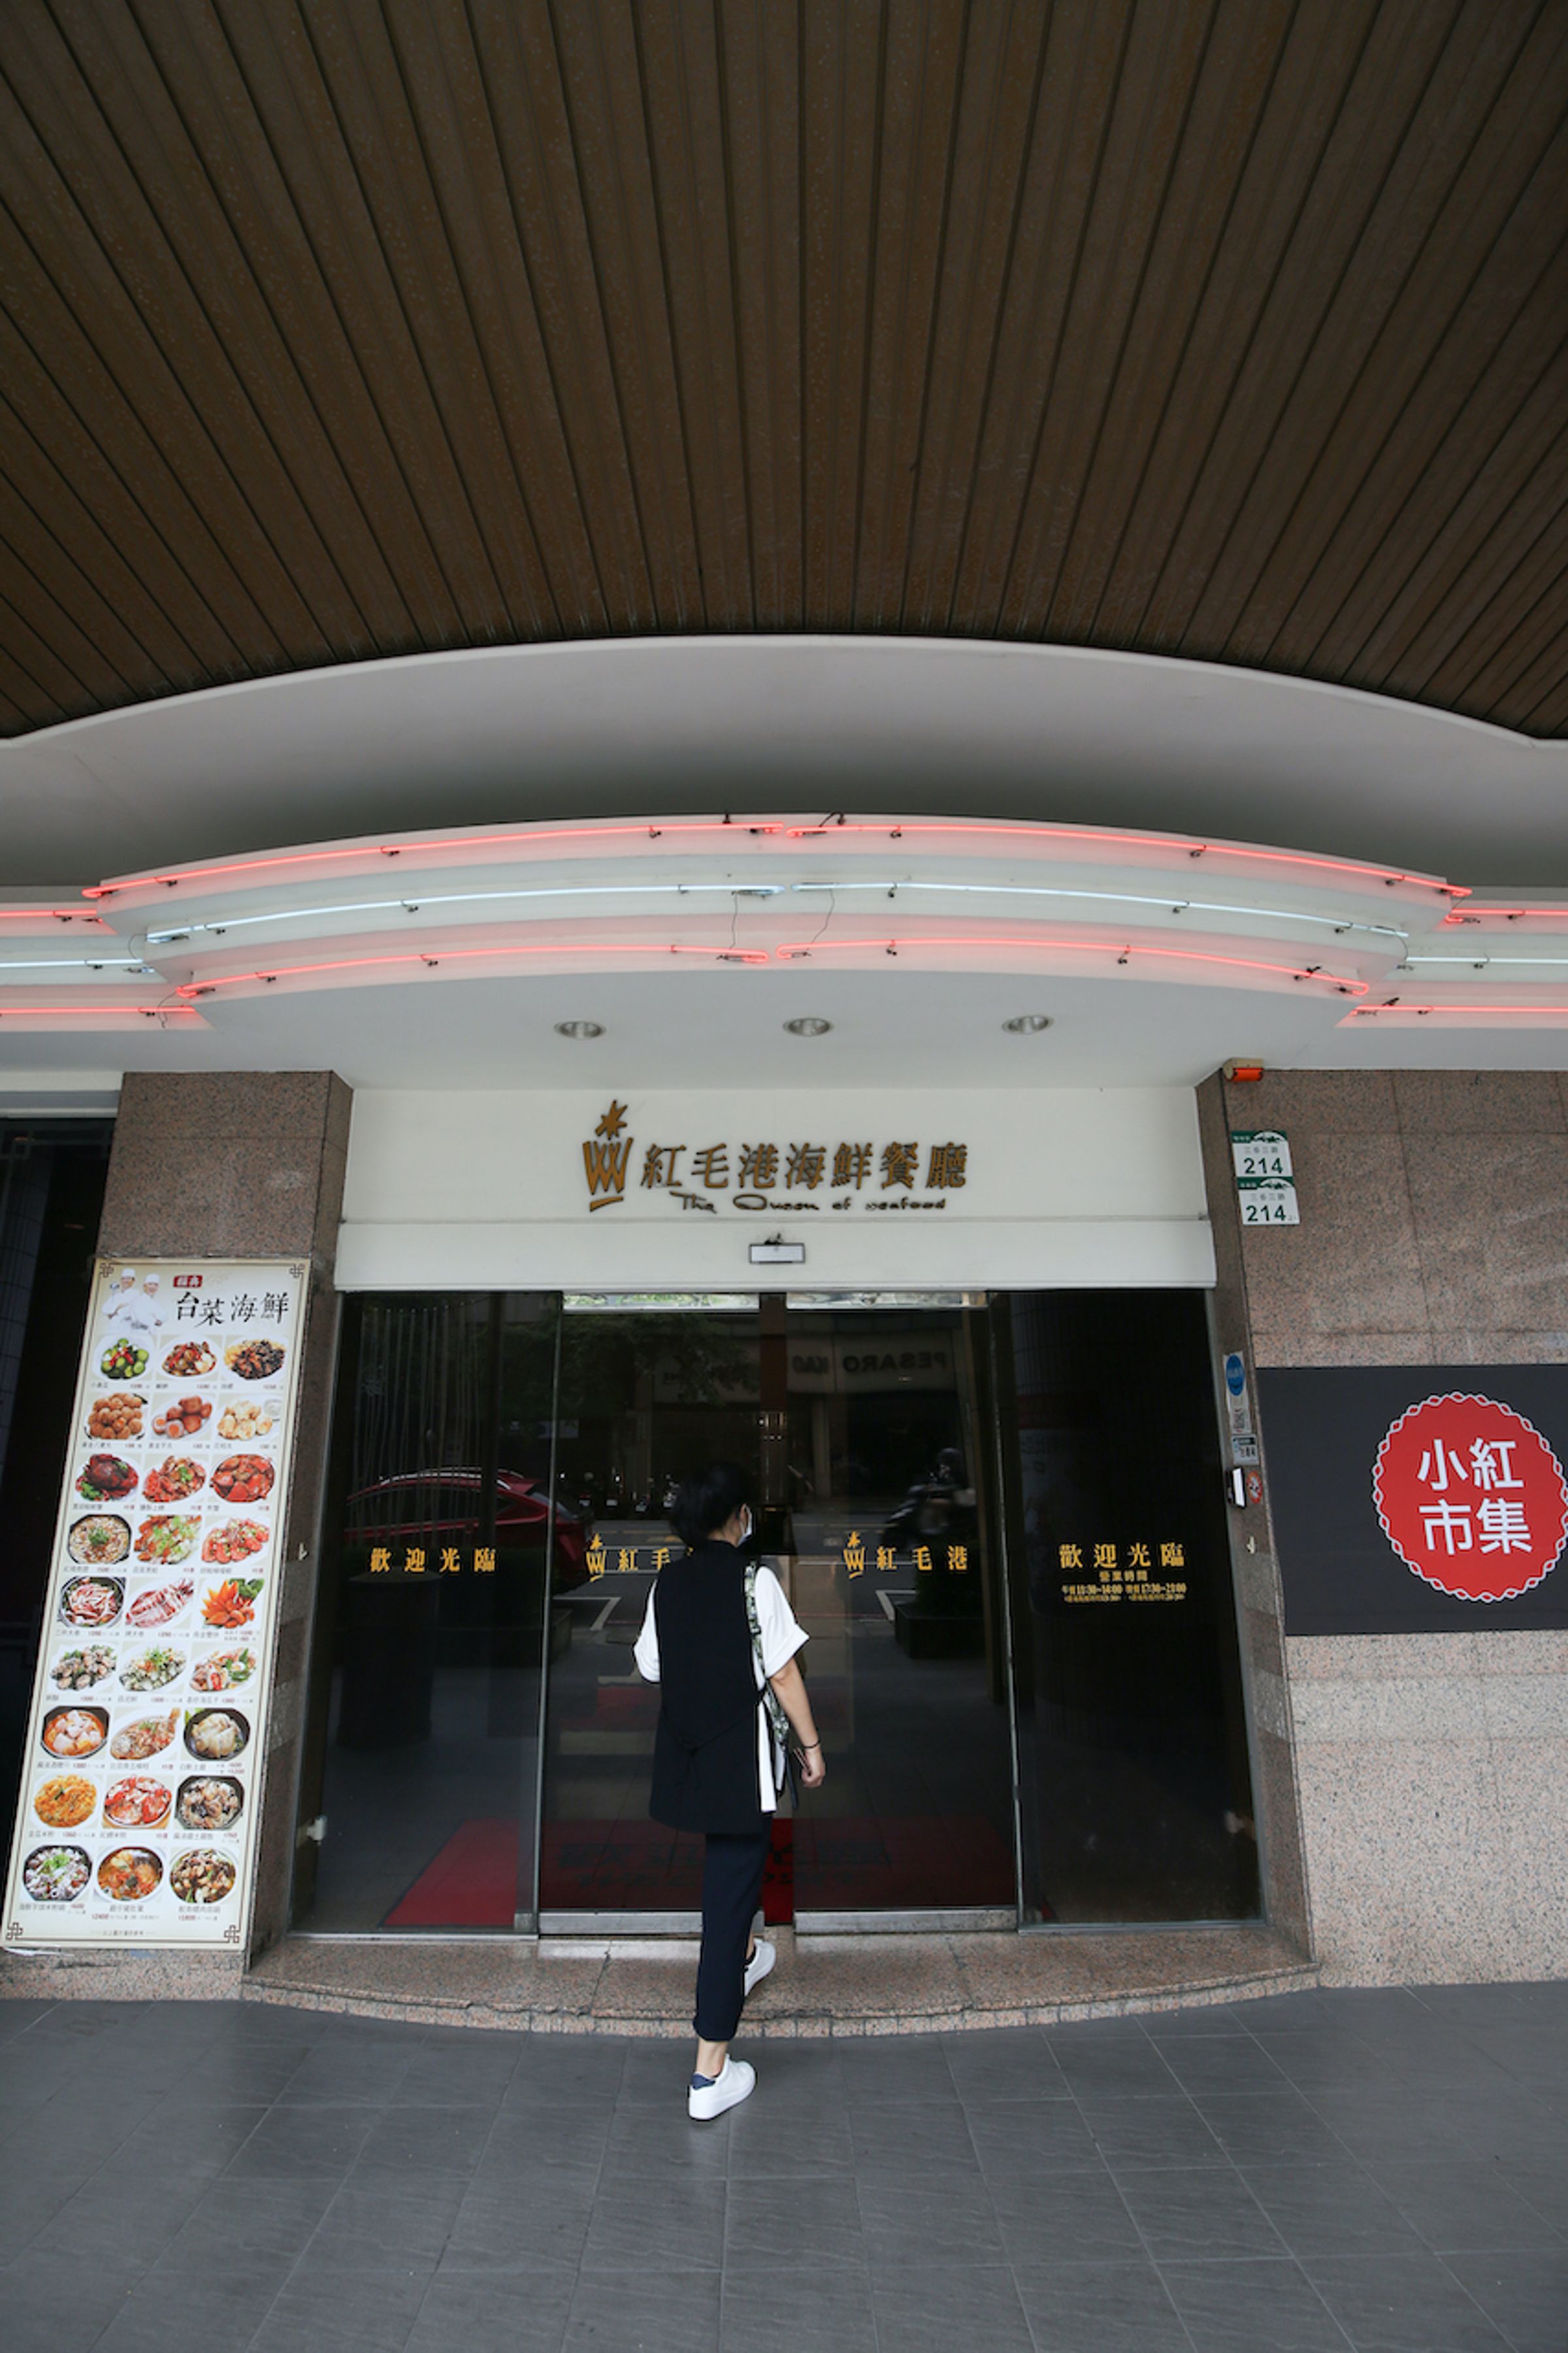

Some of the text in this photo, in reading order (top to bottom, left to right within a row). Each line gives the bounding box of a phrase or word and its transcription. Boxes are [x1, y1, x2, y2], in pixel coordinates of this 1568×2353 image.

[640, 1141, 968, 1190] 紅毛港海鮮餐廳
[1244, 1157, 1283, 1174] 214
[669, 1191, 717, 1214] The
[733, 1194, 819, 1211] Queen
[832, 1196, 851, 1211] of
[1246, 1205, 1286, 1222] 214
[176, 1291, 289, 1328] 台菜海鮮
[1417, 1438, 1524, 1491] 小紅
[1418, 1498, 1533, 1556] 市集
[370, 1547, 496, 1573] 歡迎光臨
[617, 1547, 694, 1572] 紅毛
[877, 1545, 968, 1571] 紅毛港
[1058, 1543, 1184, 1569] 歡迎光臨
